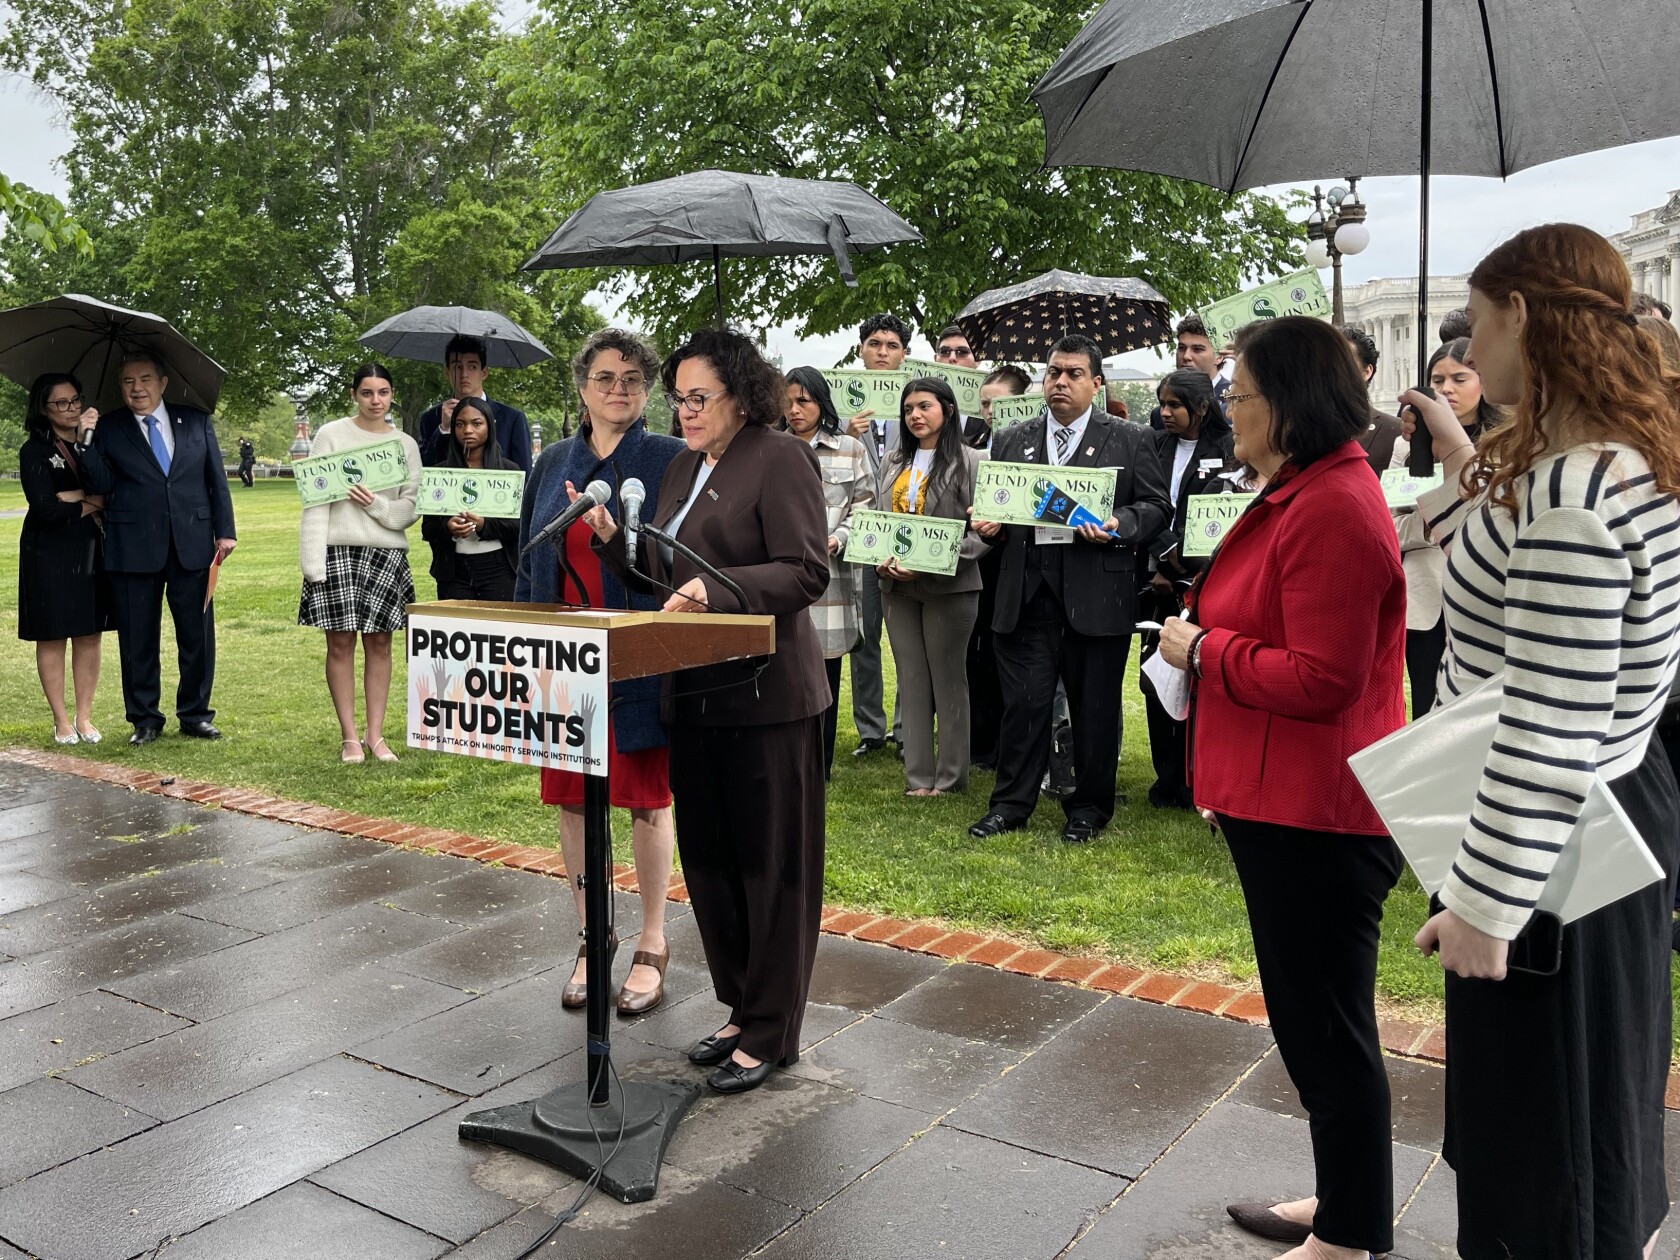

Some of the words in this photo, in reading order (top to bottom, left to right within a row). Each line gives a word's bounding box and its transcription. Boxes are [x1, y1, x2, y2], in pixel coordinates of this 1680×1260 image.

[826, 378, 842, 388] ND
[873, 380, 900, 392] HSIs
[956, 376, 979, 388] MSIs
[1000, 404, 1034, 418] FUND
[302, 462, 336, 478] FUND
[366, 450, 392, 464] MSIs
[426, 476, 458, 488] FUND
[486, 479, 512, 490] MSIs
[986, 473, 1027, 488] FUND
[1066, 479, 1098, 493] MSIs
[1196, 506, 1238, 519] FUND
[858, 520, 892, 534] FUND
[921, 528, 950, 542] MSIs
[412, 628, 600, 674] PROTECTING
[465, 668, 530, 704] OUR
[422, 698, 586, 747] STUDENTS
[412, 732, 441, 744] TRUMP'S
[442, 736, 469, 748] ATTACK
[470, 740, 481, 749] ON
[482, 742, 516, 754] MINORITY
[518, 746, 549, 759] SERVING
[550, 752, 601, 766] INSTITUTIONS
